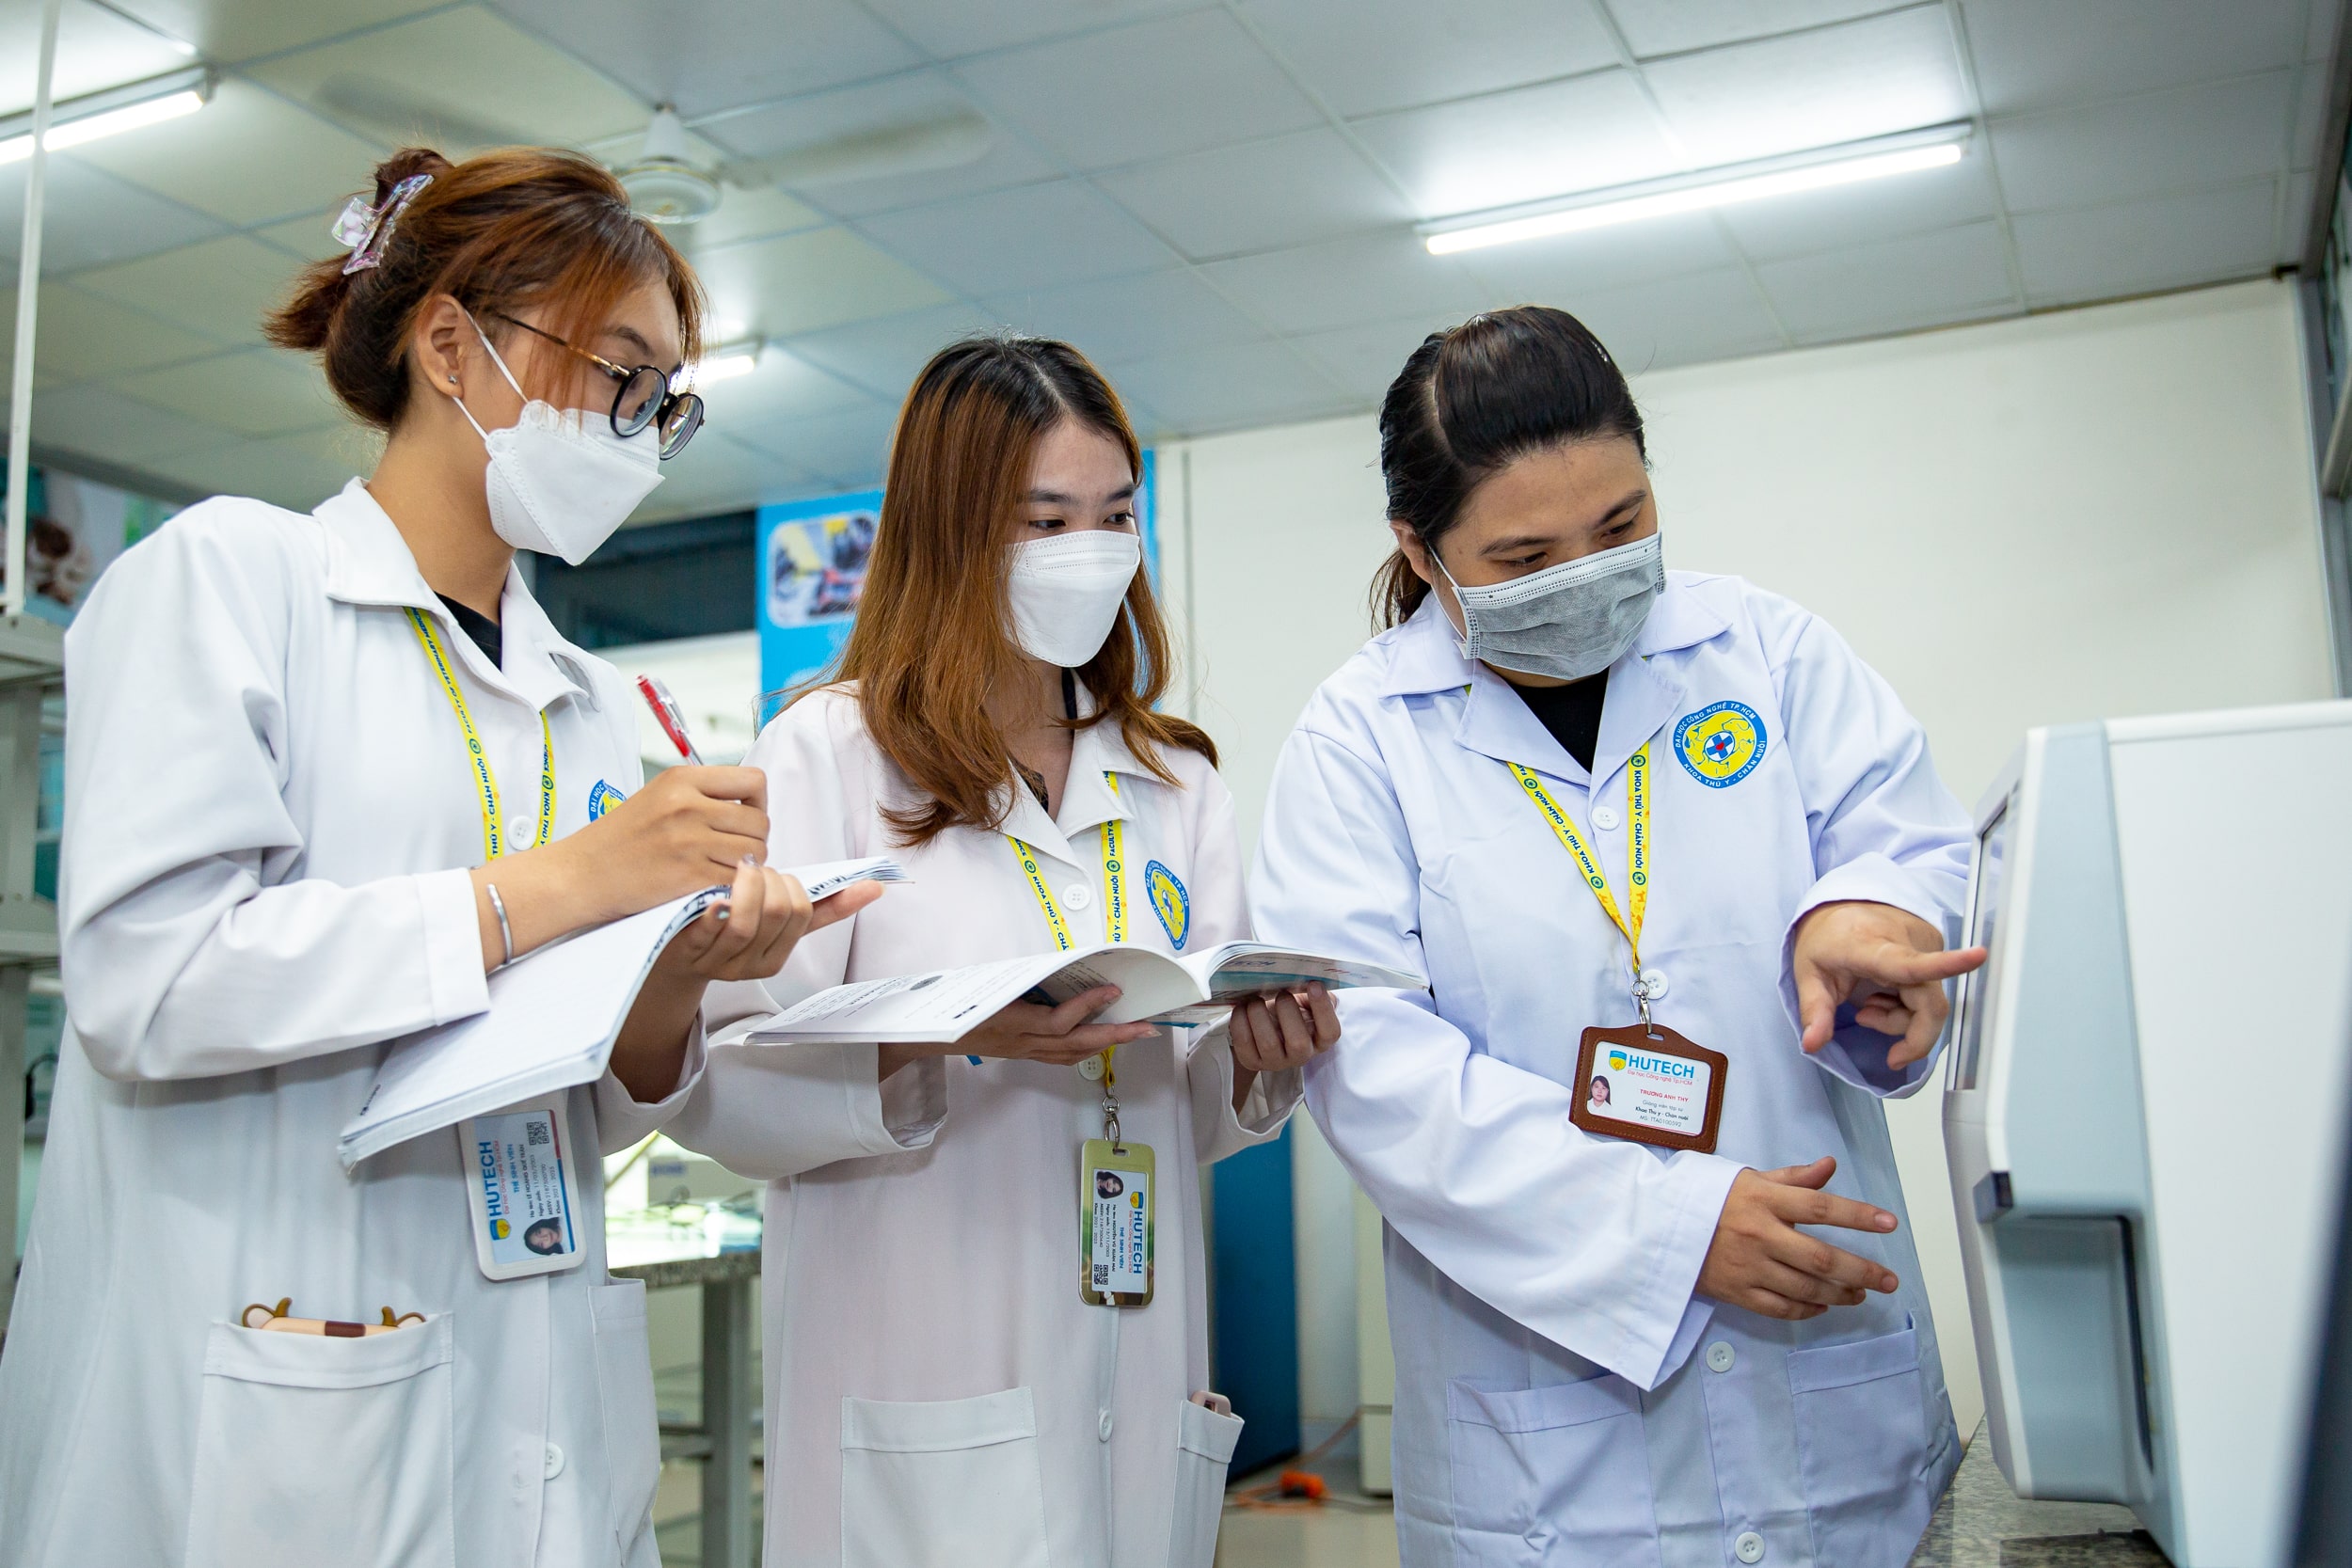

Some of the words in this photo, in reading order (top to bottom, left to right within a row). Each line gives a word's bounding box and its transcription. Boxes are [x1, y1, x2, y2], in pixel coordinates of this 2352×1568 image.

[1684, 763, 1701, 781] KHOA
[1534, 791, 1549, 806] NUÔI
[1635, 794, 1644, 809] THÚ
[1567, 835, 1581, 850] THÚ
[1580, 851, 1595, 874] KHOA
[1635, 847, 1644, 868] NUÔI
[1110, 876, 1119, 895] NUÔI
[1033, 877, 1046, 899] KHOA
[1045, 901, 1056, 918] THÚ
[1629, 1055, 1694, 1078] HUTECH
[479, 1141, 502, 1216] HUTECH
[1134, 1212, 1142, 1274] HUTECH
